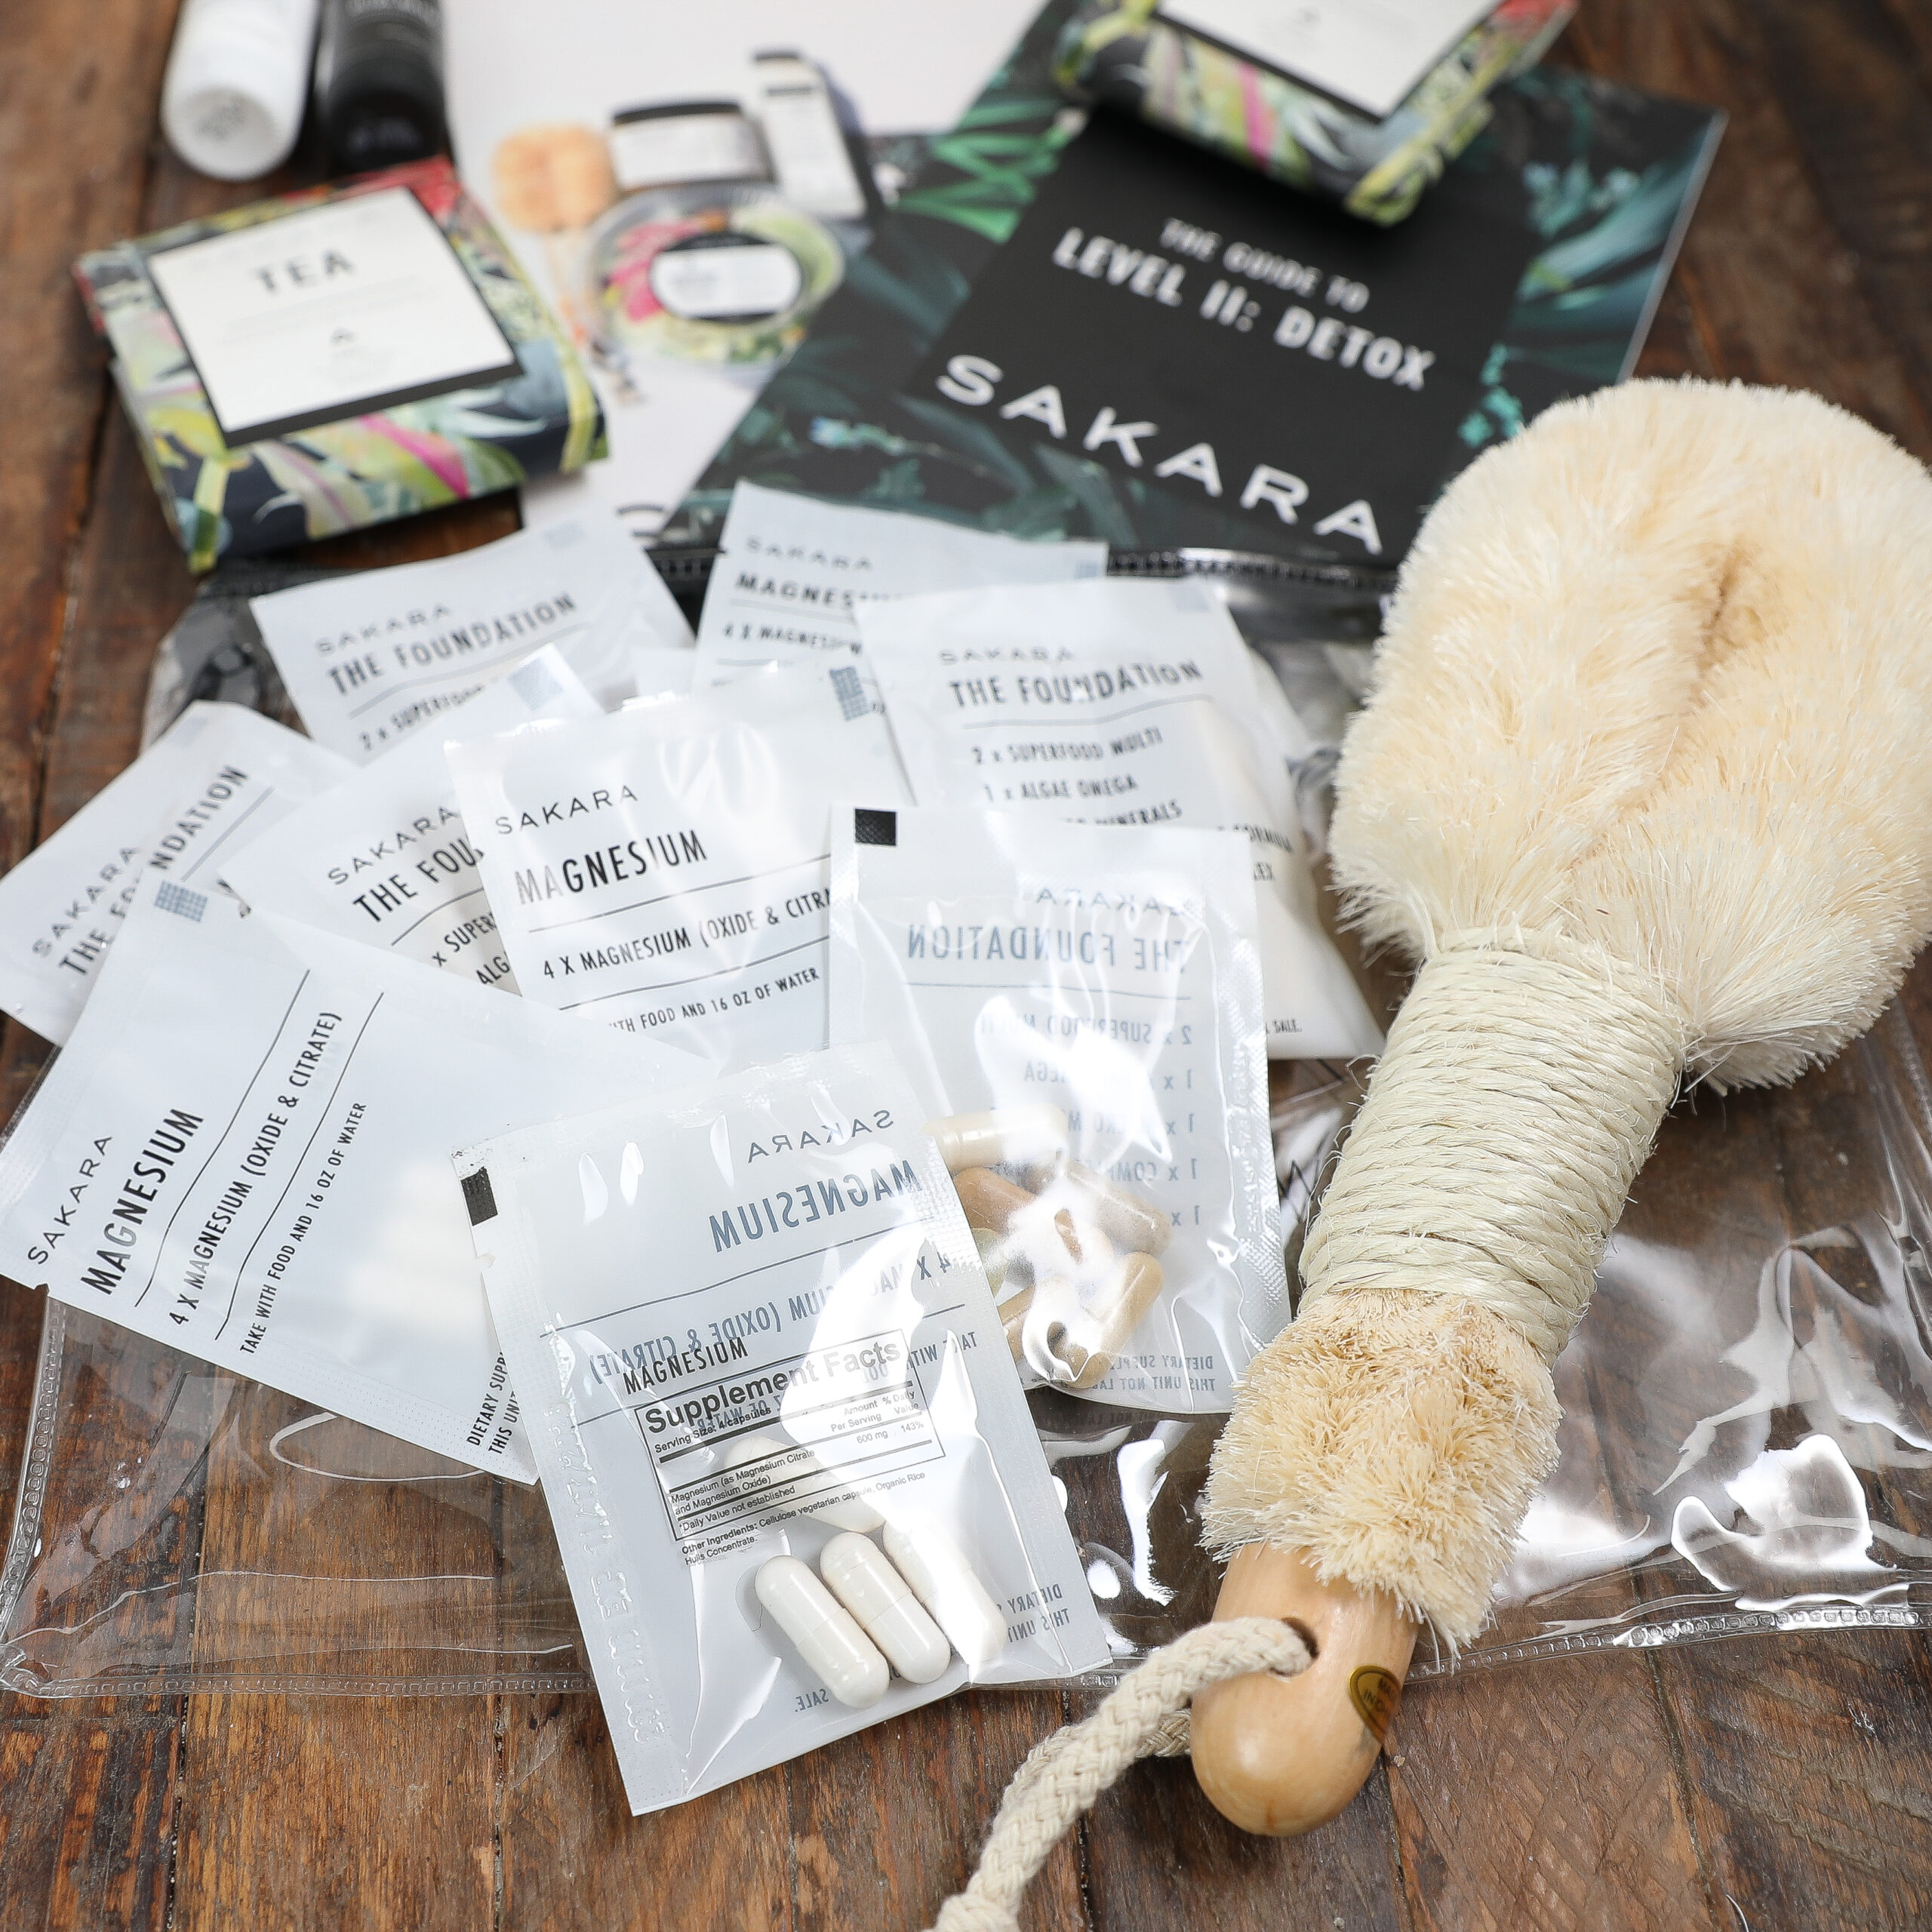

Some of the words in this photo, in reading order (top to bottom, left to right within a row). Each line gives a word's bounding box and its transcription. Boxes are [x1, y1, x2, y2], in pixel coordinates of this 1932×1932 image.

[254, 248, 355, 294] TEA
[1160, 217, 1223, 262] THE
[1222, 242, 1324, 298] GUIDE
[1324, 273, 1370, 312] TO
[1052, 227, 1187, 306] LEVEL
[1200, 279, 1261, 332] II:
[1273, 306, 1435, 391] DETOX
[936, 354, 1383, 555] SAKARA
[737, 572, 891, 608] MAGNES
[327, 652, 383, 696] THE
[394, 592, 577, 669] FOUNDATION
[949, 676, 1006, 709] THE
[1018, 660, 1204, 705] FOUNDATION
[495, 785, 639, 835] SAKARA
[59, 928, 108, 976] THE
[109, 764, 249, 920] FONDATION
[328, 806, 459, 885] SAKARA
[515, 829, 708, 906] MAGNESIUM
[32, 846, 139, 958] SAKARA
[352, 874, 418, 923] THE
[416, 838, 485, 883] FOU
[475, 952, 511, 986] ALG
[543, 960, 555, 979] 4
[560, 955, 576, 976] X
[580, 927, 692, 971] MAGNESIUM
[698, 909, 758, 949] (OXIDE
[765, 906, 780, 925] &
[640, 1006, 676, 1029] FOOD
[682, 1002, 706, 1019] AND
[712, 998, 728, 1014] 16
[733, 990, 752, 1007] OZ
[755, 982, 774, 1000] OF
[775, 967, 820, 993] WATER
[288, 1011, 343, 1088] CITRATE)
[278, 1094, 300, 1108] &
[240, 1112, 289, 1177] (OXIDE
[27, 1135, 113, 1265] SAKARA
[80, 1108, 205, 1296] MAGNESIUM
[239, 1322, 266, 1355] TAKE
[256, 1284, 278, 1320] WITH
[267, 1244, 296, 1281] FOOD
[289, 1214, 313, 1242] AND
[306, 1193, 325, 1210] 16
[316, 1169, 336, 1190] OZ
[328, 1147, 345, 1167] OF
[337, 1102, 368, 1146] WATER
[183, 1180, 254, 1291] MAGNESIUM
[169, 1311, 189, 1325] 4
[177, 1293, 200, 1310] X
[623, 1337, 748, 1395] MAGNESIUM
[645, 1361, 819, 1433] Supplement
[823, 1342, 900, 1377] Facts
[466, 1392, 499, 1446] DIETARY
[489, 1352, 509, 1392] SUPP
[654, 1435, 691, 1454] Serving
[694, 1424, 717, 1439] Size:
[727, 1407, 771, 1427] capsules
[831, 1423, 845, 1432] Per
[848, 1414, 881, 1427] Serving
[894, 1403, 918, 1415] Value
[844, 1400, 878, 1416] Amount
[893, 1391, 915, 1402] Daily
[488, 1426, 512, 1454] THIS
[857, 1433, 872, 1444] 600
[875, 1430, 888, 1440] mg
[901, 1421, 924, 1433] 143%
[671, 1481, 719, 1504] Magnesium
[721, 1475, 734, 1487] (as
[735, 1459, 786, 1481] Magnesium
[786, 1449, 815, 1463] Citrate
[675, 1503, 691, 1515] and
[692, 1486, 741, 1511] Magnesium
[743, 1475, 771, 1491] Oxide)
[705, 1509, 731, 1523] Value
[732, 1502, 746, 1514] not
[746, 1485, 796, 1507] established
[681, 1541, 706, 1555] Other
[706, 1523, 758, 1546] Ingredients:
[759, 1509, 797, 1526] Cellulose
[798, 1494, 841, 1515] vegetarian
[875, 1477, 906, 1491] Organic
[907, 1472, 926, 1482] Rice
[685, 1554, 706, 1566] Hulls
[706, 1536, 758, 1557] Concentrate.
